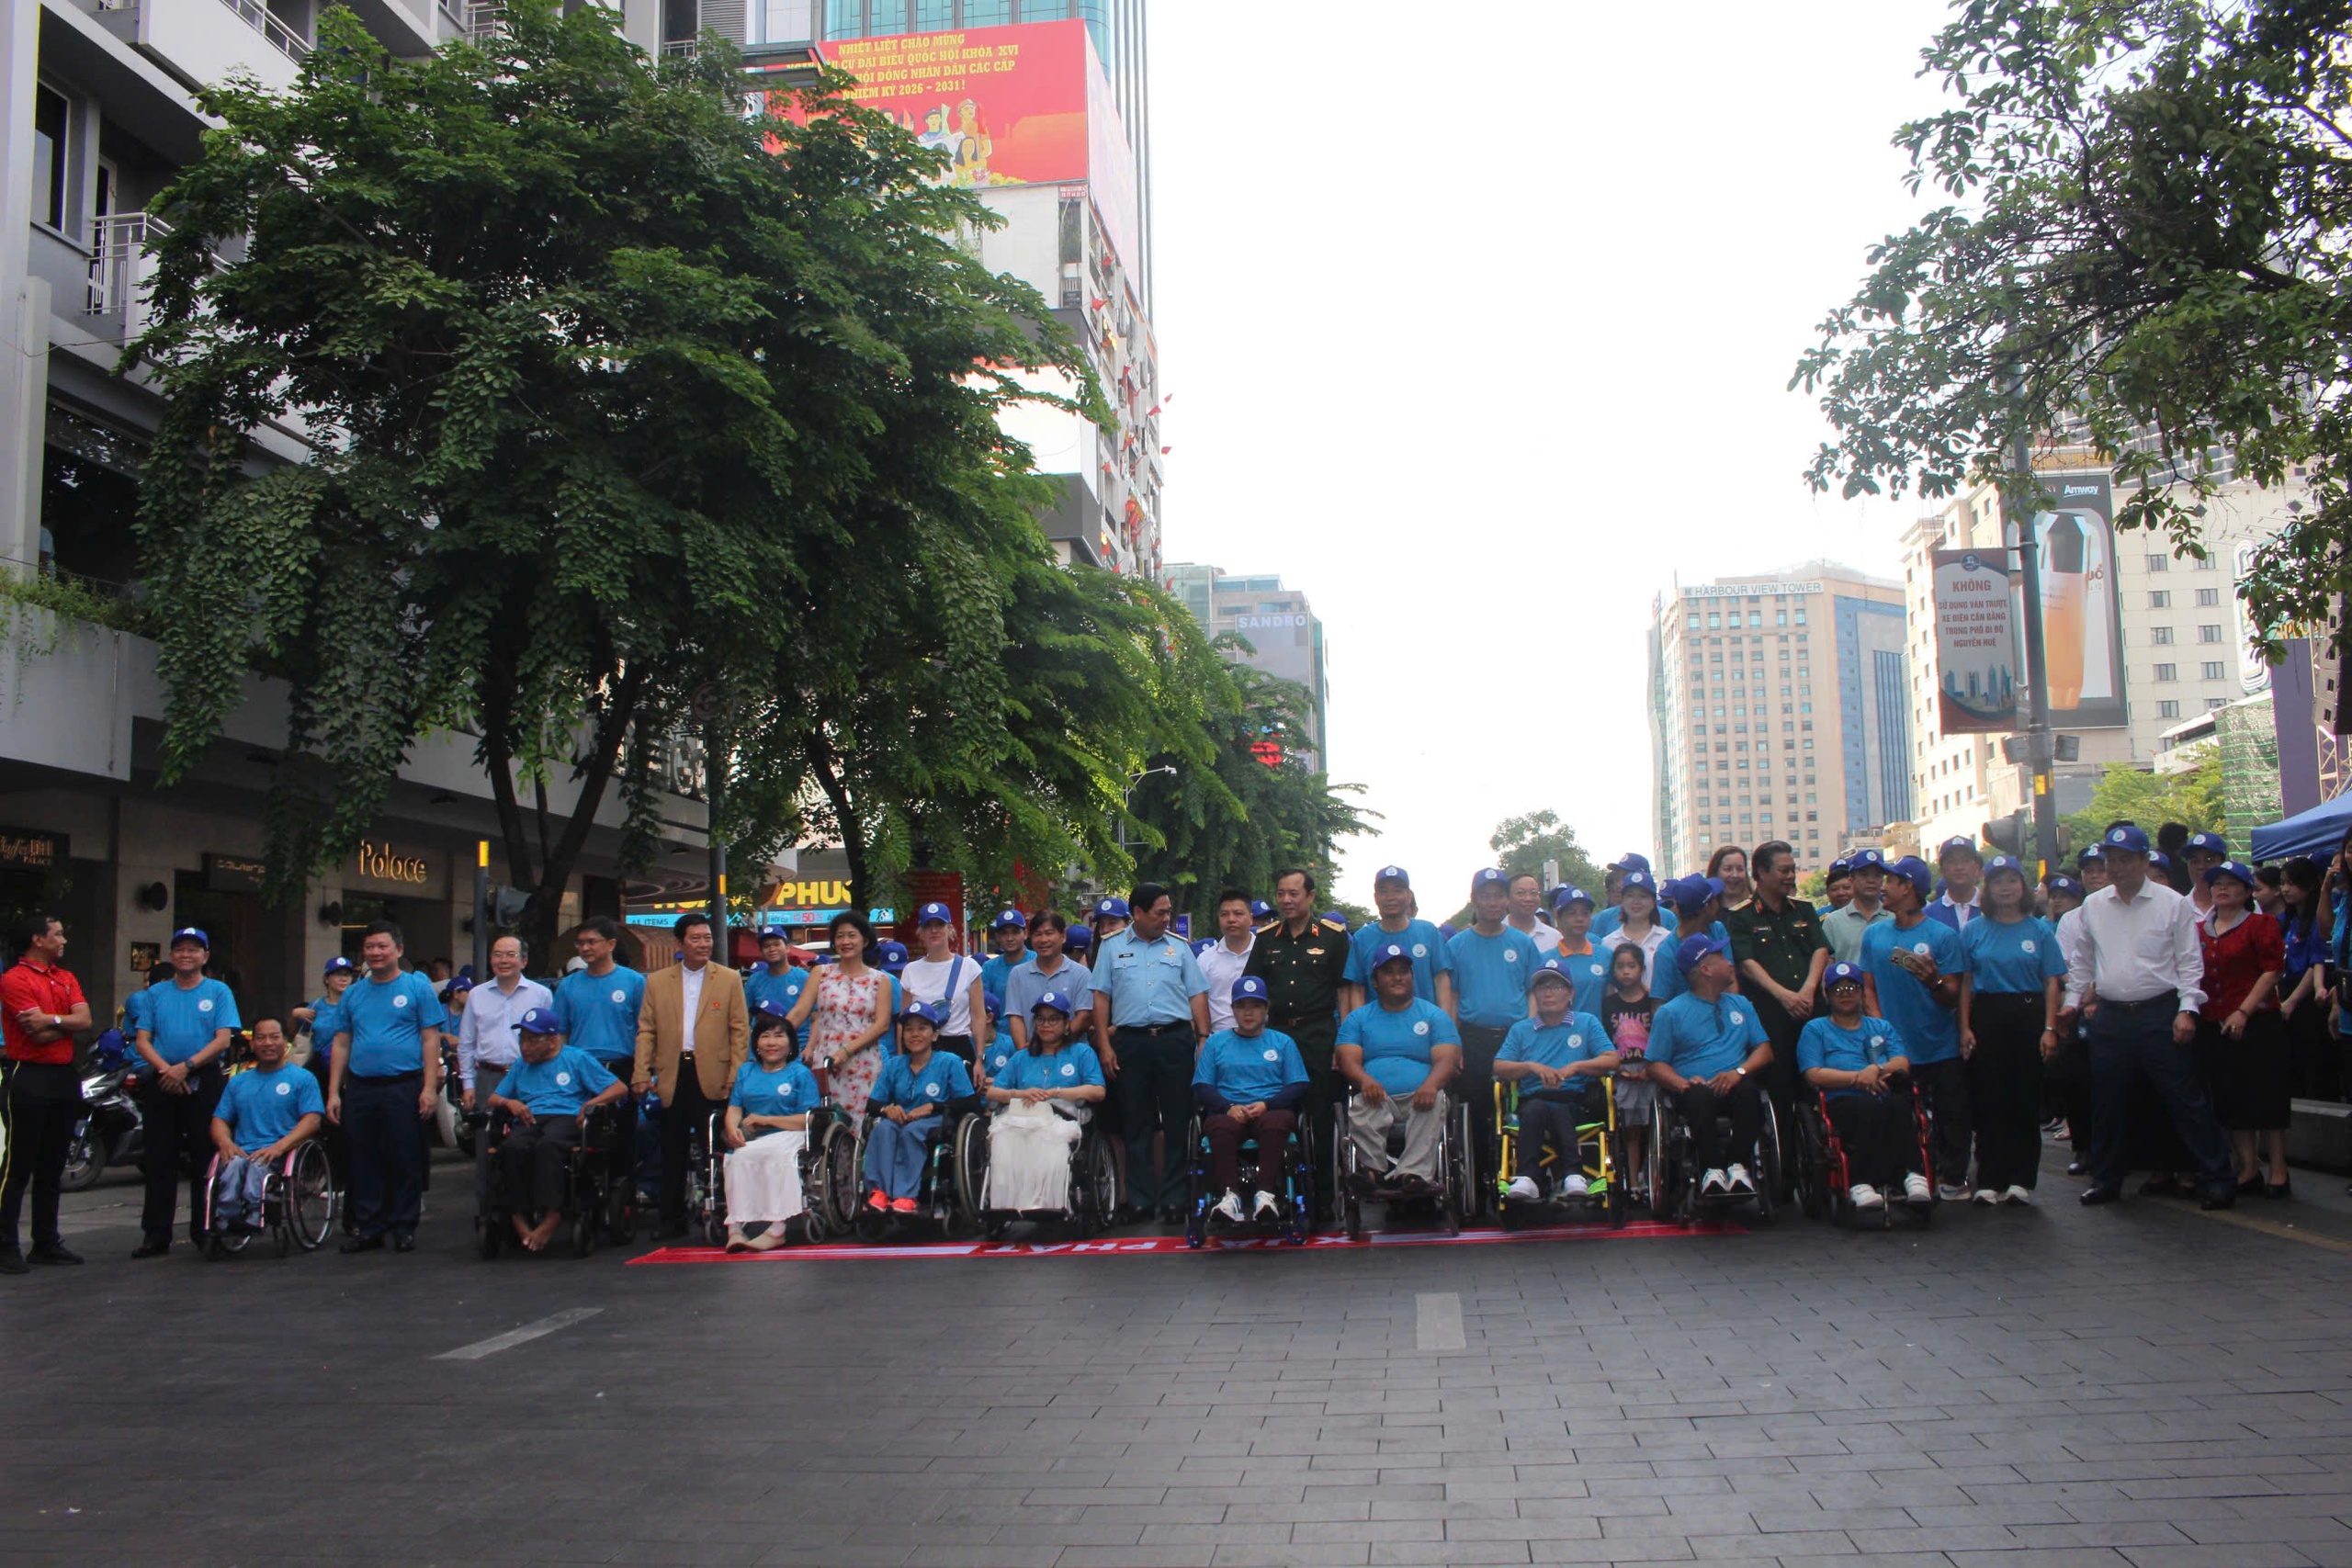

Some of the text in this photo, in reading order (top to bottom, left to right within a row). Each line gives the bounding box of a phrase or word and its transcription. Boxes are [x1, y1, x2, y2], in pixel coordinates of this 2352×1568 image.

[999, 44, 1019, 56] XVI
[899, 83, 923, 96] 2026
[2064, 484, 2099, 495] Amway
[1695, 581, 1822, 596] HARBOUR VIEW TOWER
[1952, 579, 1991, 592] KHÔNG
[358, 839, 427, 884] Palace
